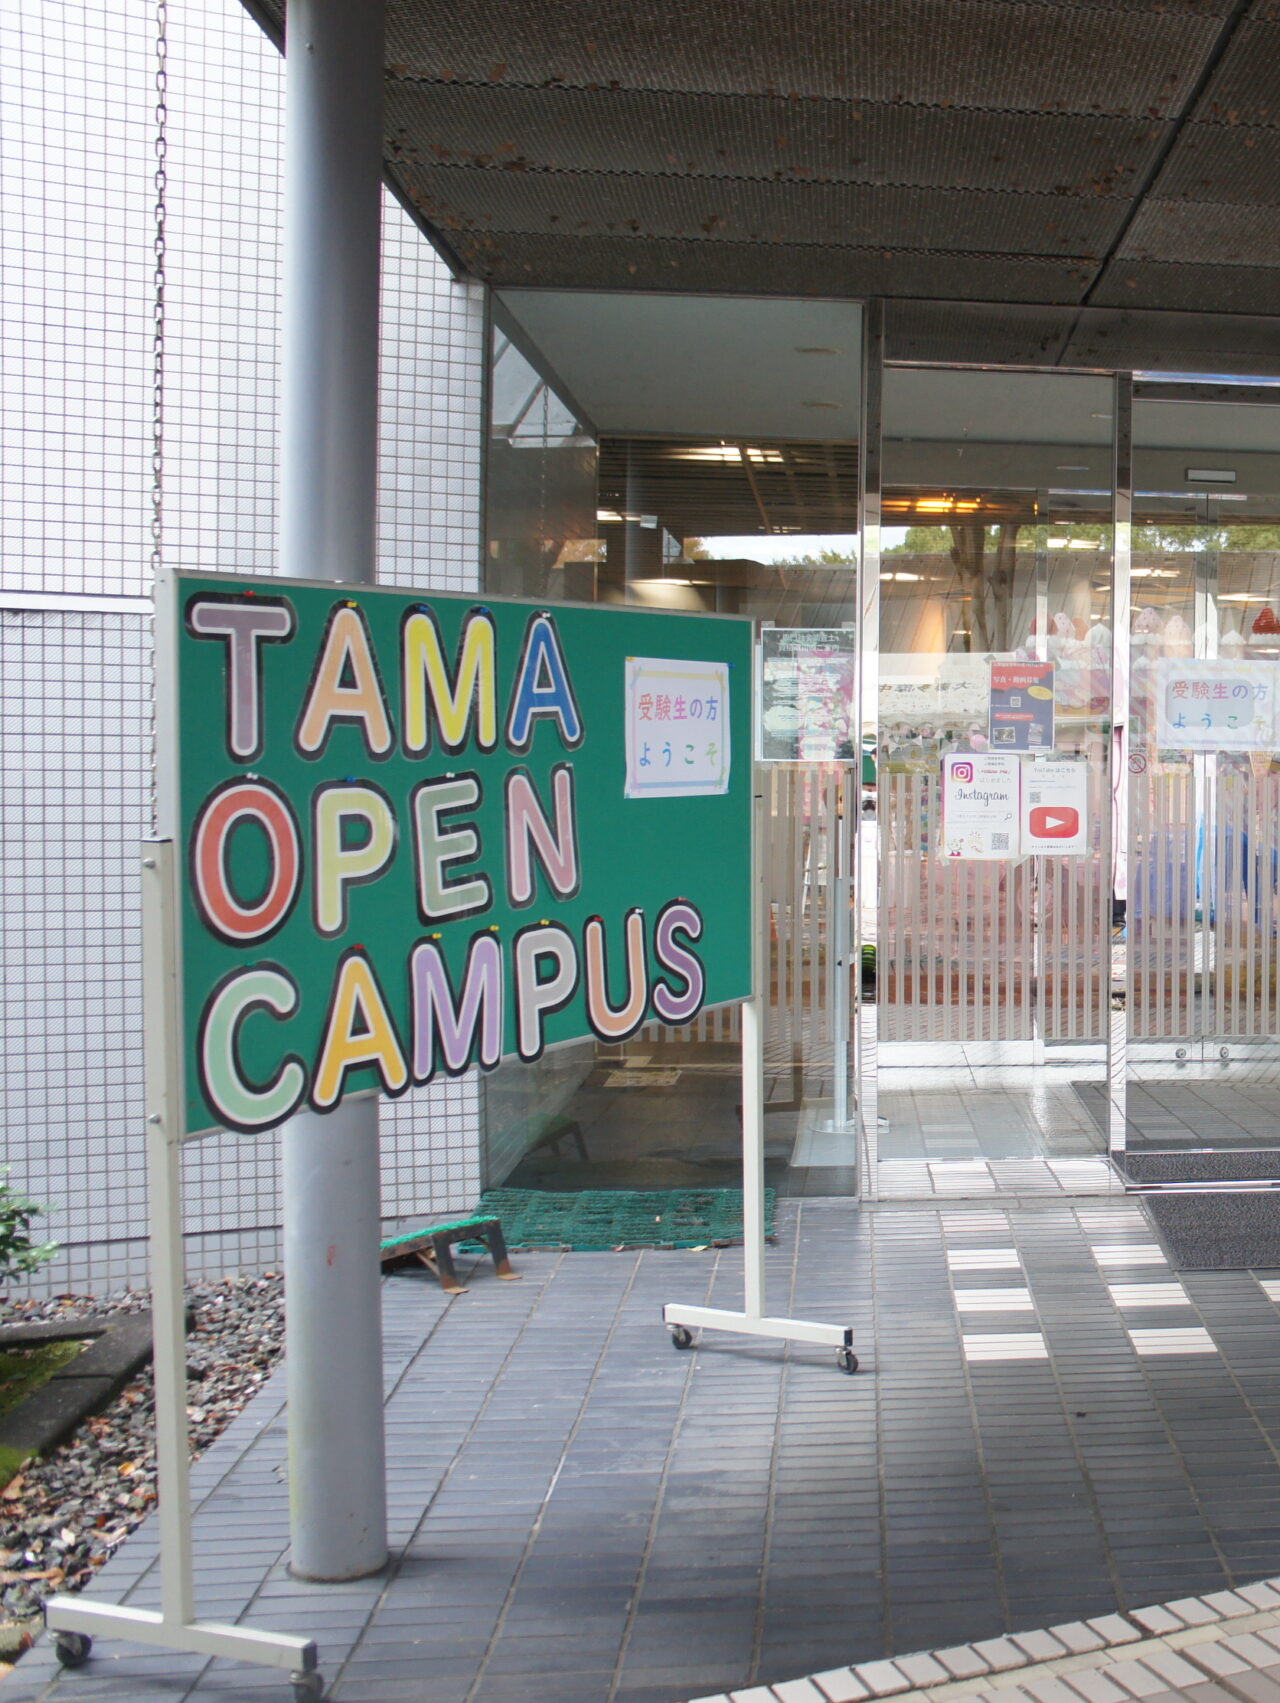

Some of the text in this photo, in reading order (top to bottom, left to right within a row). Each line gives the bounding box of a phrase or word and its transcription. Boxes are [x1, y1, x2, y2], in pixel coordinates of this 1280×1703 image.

[185, 593, 585, 764] TAMA
[1172, 681, 1268, 701] 受験生の方
[638, 693, 718, 721] 受験生の方
[1172, 712, 1267, 730] ようこそ
[639, 741, 718, 767] ようこそ
[955, 788, 1009, 807] Instagram
[190, 762, 583, 948] OPEN
[198, 899, 706, 1135] CAMPUS
